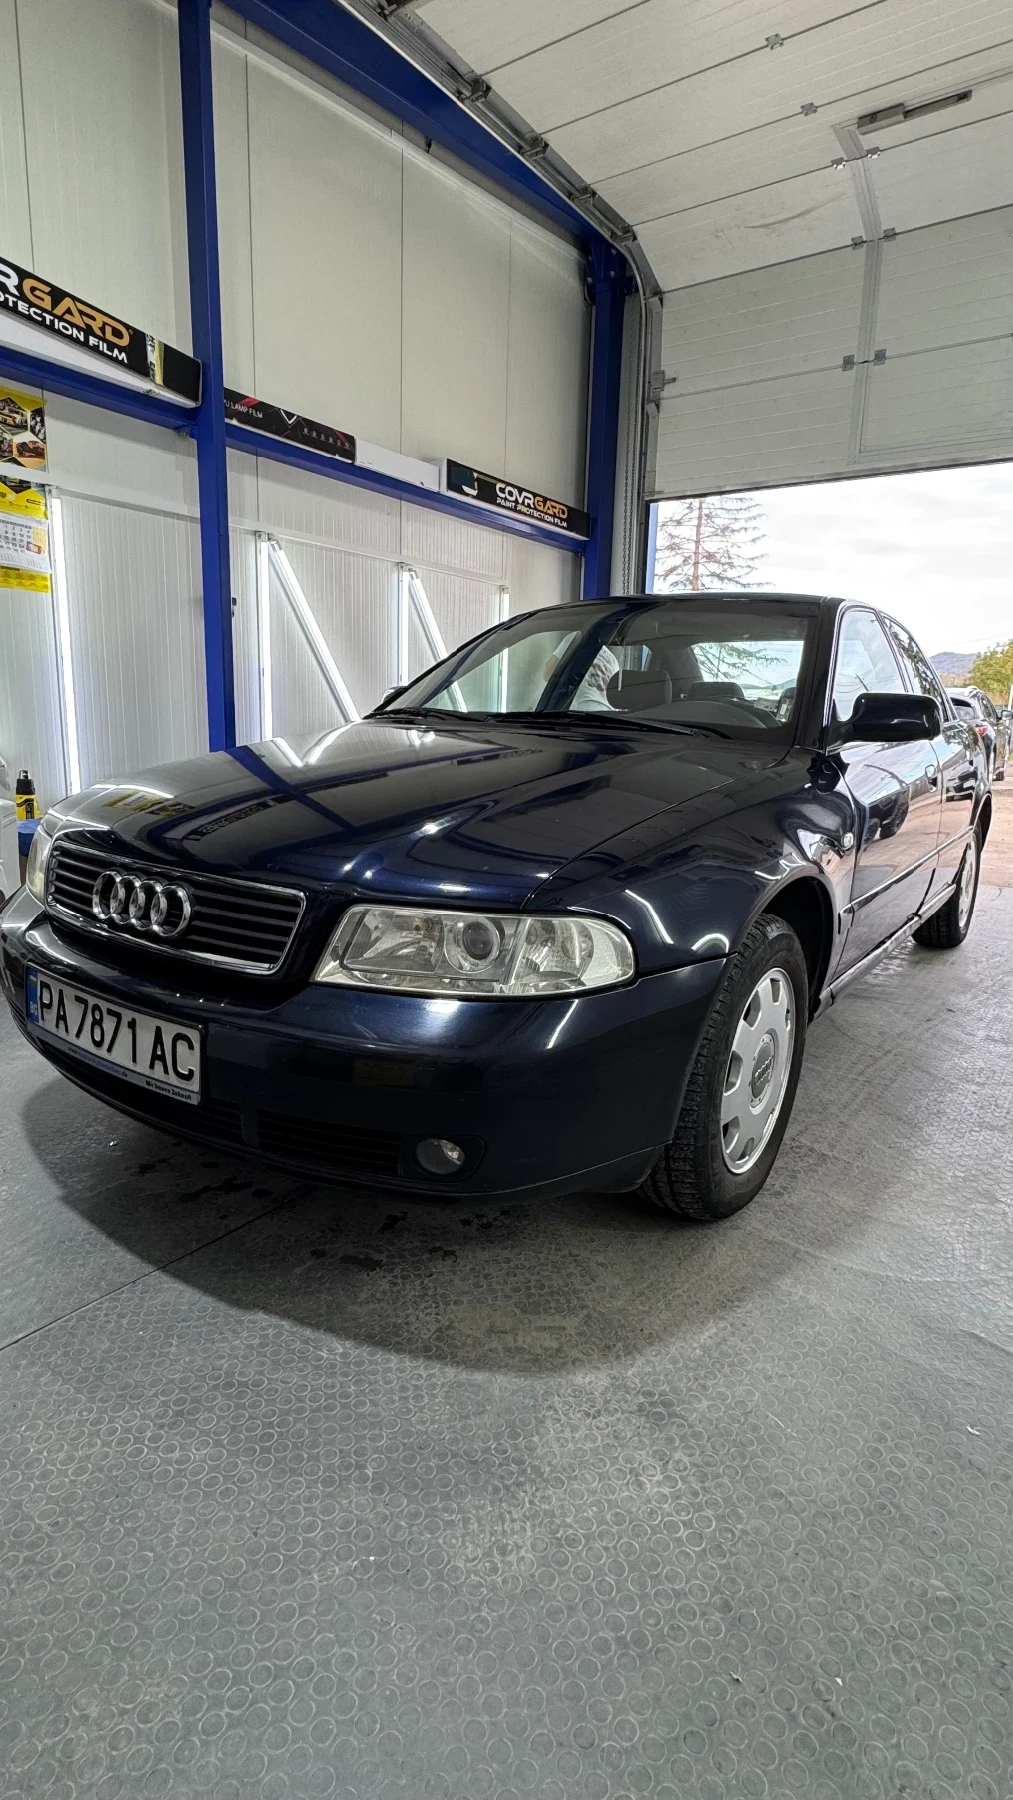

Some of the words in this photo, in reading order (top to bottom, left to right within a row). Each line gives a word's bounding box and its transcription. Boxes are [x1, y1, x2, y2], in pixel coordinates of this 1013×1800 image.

[88, 335, 128, 364] FILM
[231, 402, 248, 413] LAMP
[249, 408, 263, 419] FILM
[495, 482, 568, 519] COVRGARD
[496, 497, 516, 510] PAINT
[516, 504, 554, 524] PROTECTION
[554, 518, 568, 528] FILM
